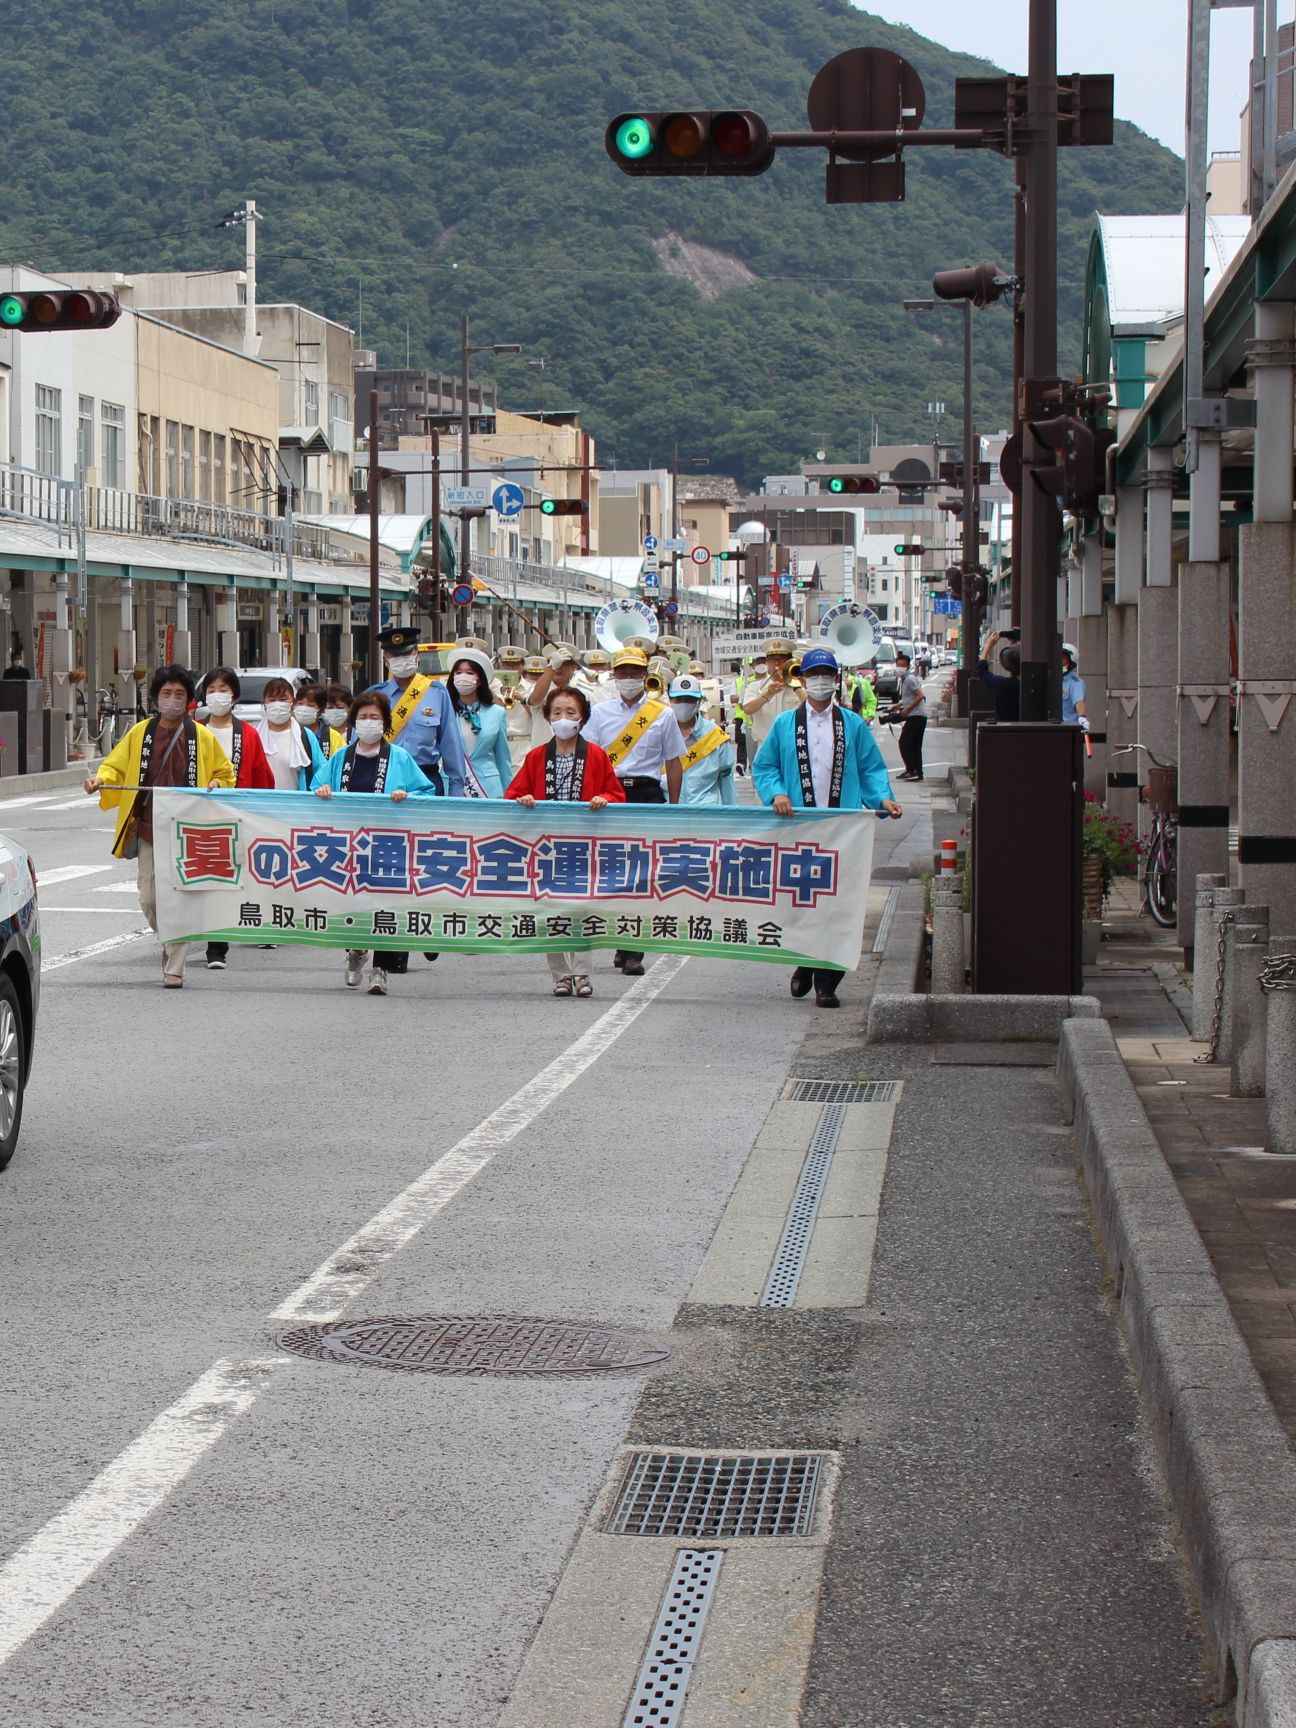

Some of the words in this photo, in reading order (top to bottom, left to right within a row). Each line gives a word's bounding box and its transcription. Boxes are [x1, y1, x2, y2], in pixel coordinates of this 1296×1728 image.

[695, 550, 706, 560] 40
[796, 725, 814, 803] 鳥取地区協会
[176, 821, 839, 908] 夏の交通安全運動実施中
[237, 901, 784, 948] 鳥取市・鳥取市交通安全対策協議会
